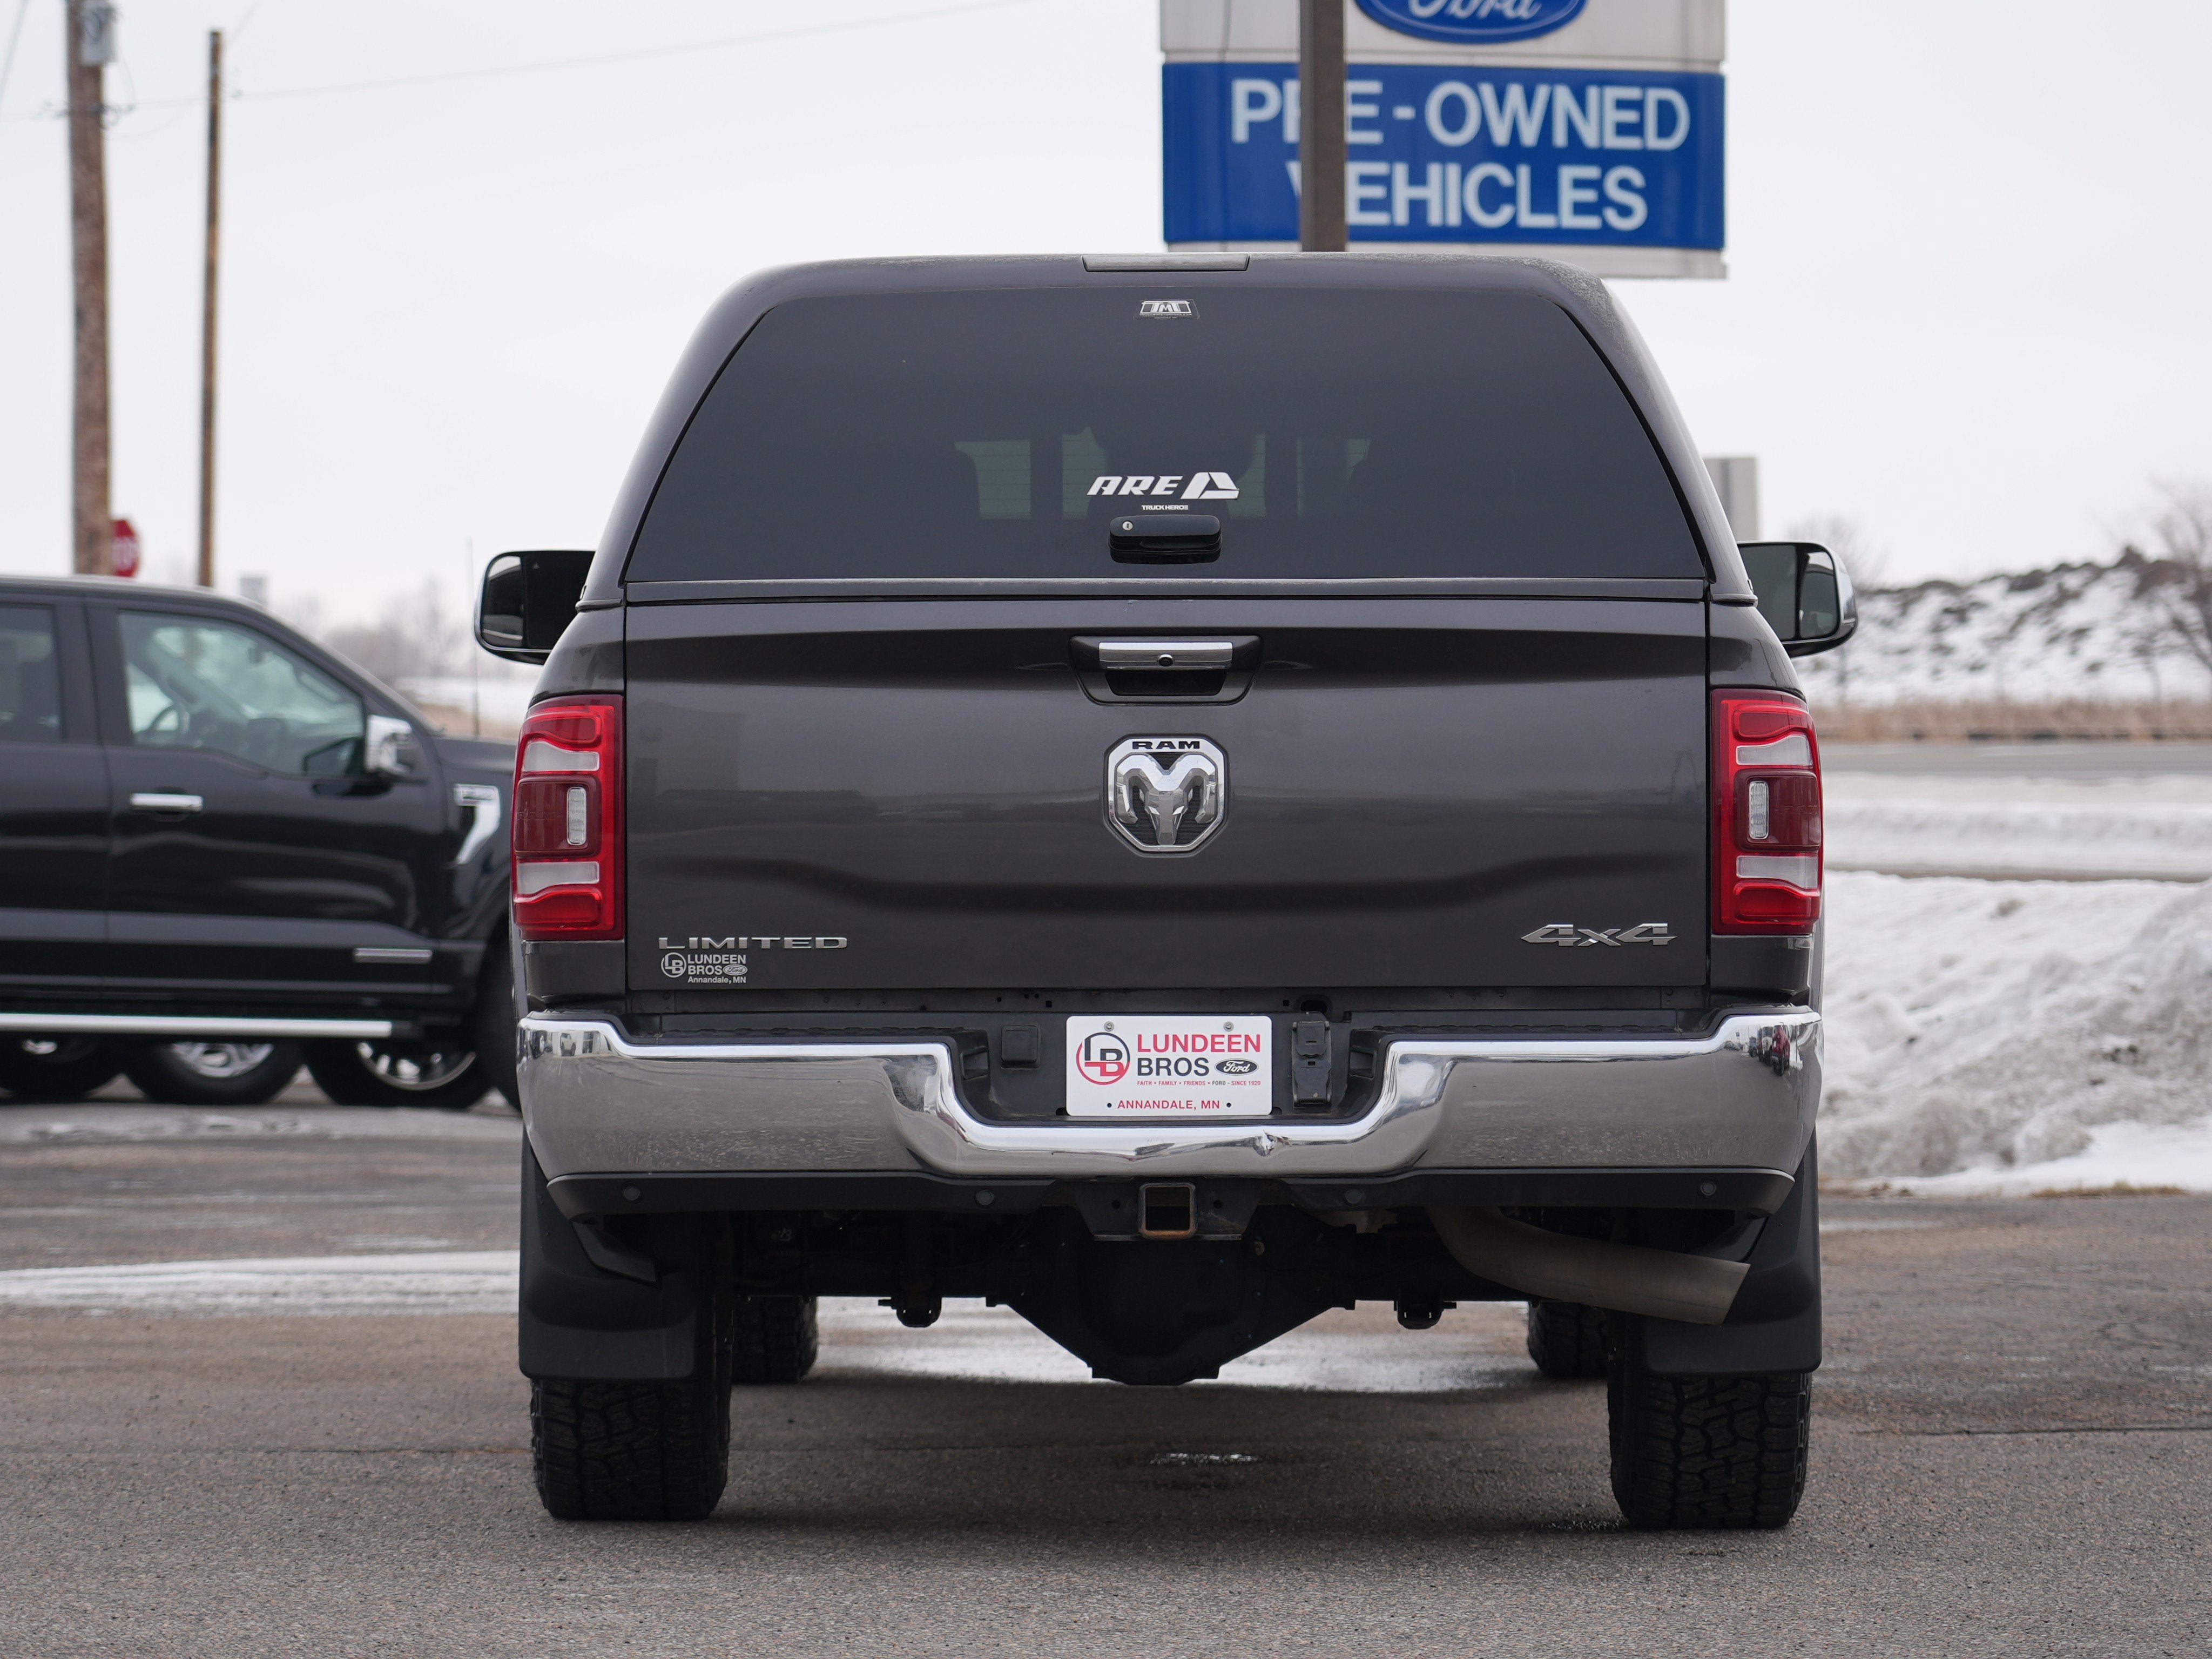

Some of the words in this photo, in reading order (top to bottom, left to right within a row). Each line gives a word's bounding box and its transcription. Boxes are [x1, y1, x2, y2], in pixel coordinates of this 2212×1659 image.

[1287, 161, 1648, 231] EHICLES
[1087, 476, 1183, 495] ARE
[1132, 741, 1200, 750] RAM
[658, 937, 847, 949] LIMITED
[687, 954, 746, 964] LUNDEEN
[687, 965, 723, 975] BROS
[687, 976, 732, 984] Annandale,
[1137, 1034, 1261, 1053] LUNDEEN
[1137, 1057, 1209, 1077] BROS
[1223, 1060, 1251, 1073] Ford
[1117, 1100, 1197, 1111] ANNANDALE,
[1201, 1100, 1220, 1109] MN
